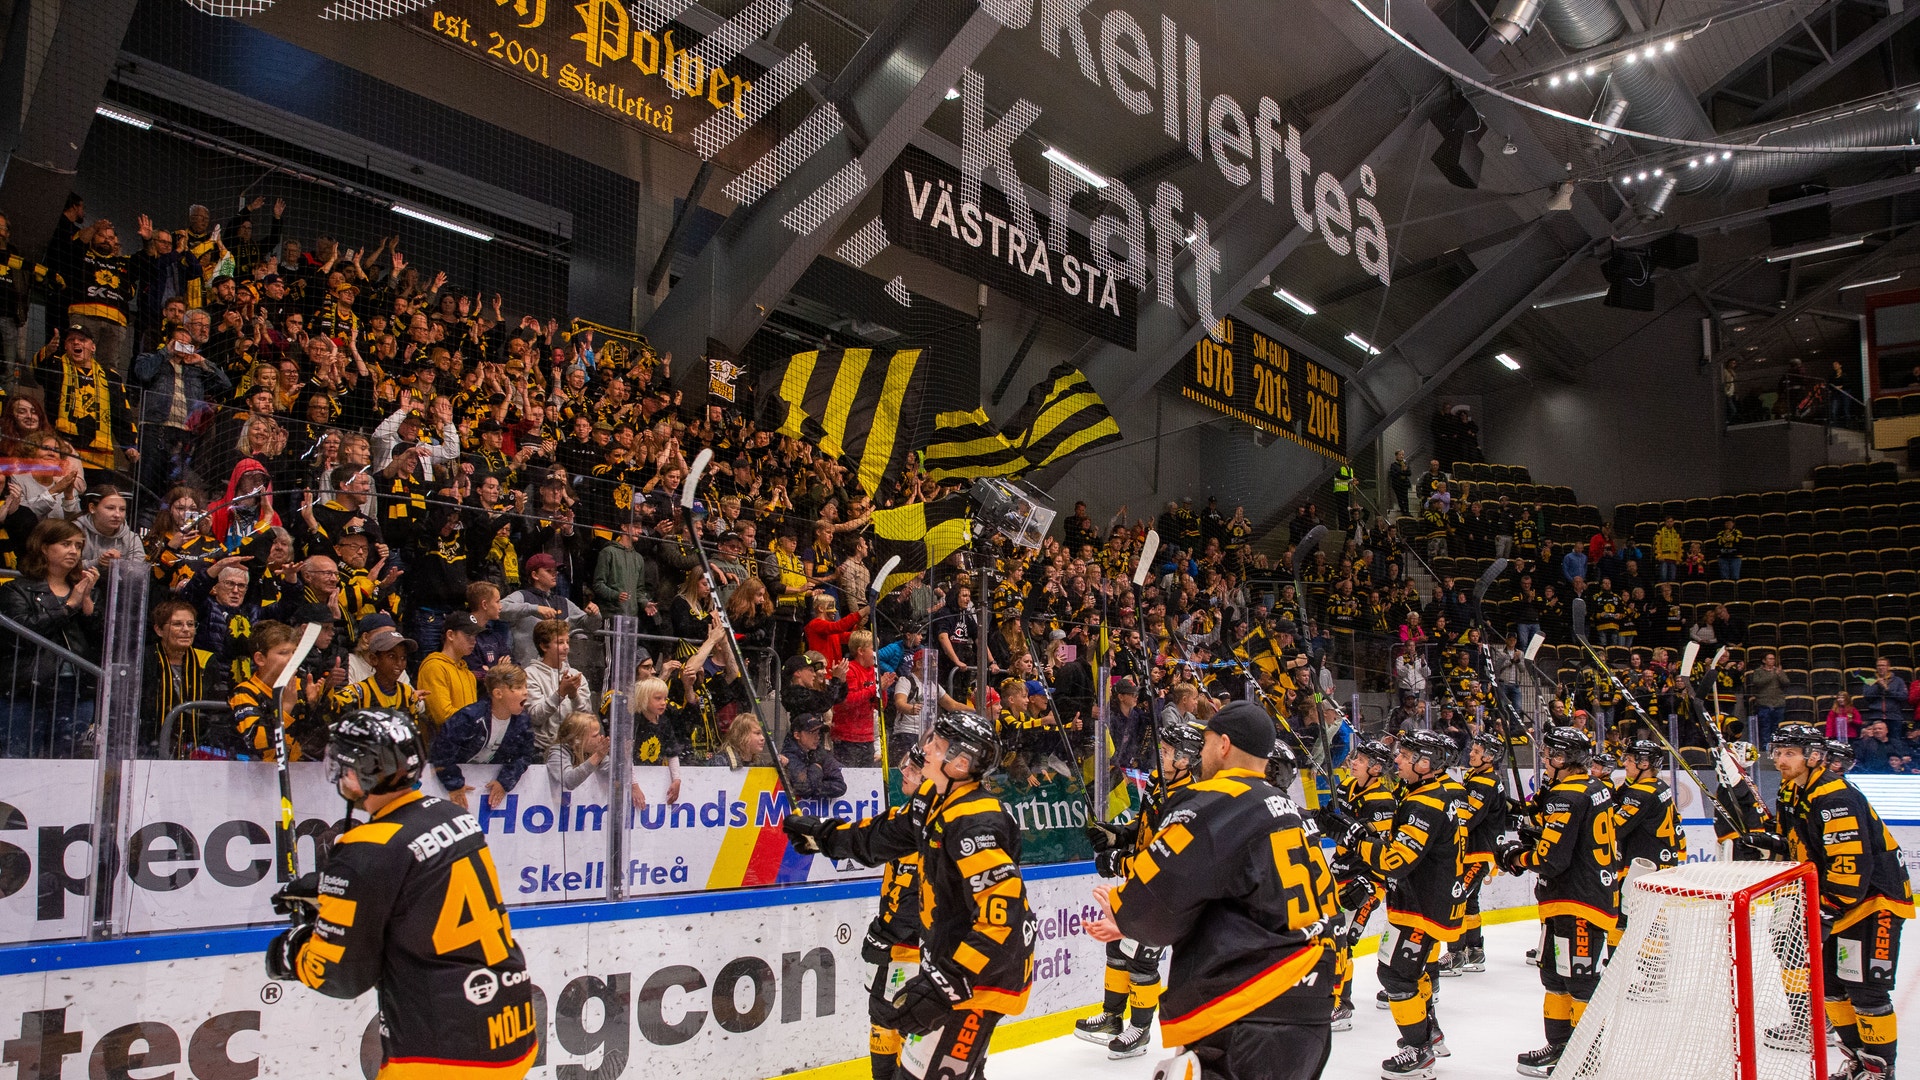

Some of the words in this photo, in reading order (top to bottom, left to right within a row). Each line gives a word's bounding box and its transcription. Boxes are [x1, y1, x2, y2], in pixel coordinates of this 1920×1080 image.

[433, 10, 478, 47] est.
[487, 31, 551, 80] 2001
[558, 62, 674, 134] Skellefteå
[571, 0, 752, 119] Power
[904, 170, 1053, 285] VÄSTRA
[1196, 338, 1235, 398] 1978
[1253, 332, 1289, 374] SM-GULD
[1253, 363, 1292, 413] 2013
[1306, 361, 1338, 398] SM-GULD
[1307, 390, 1340, 445] 2014
[1611, 676, 1646, 714] CCM
[274, 727, 286, 771] CCM
[519, 856, 688, 893] Skellfteå
[969, 870, 996, 892] SK
[1831, 856, 1857, 874] 25
[977, 897, 1008, 926] 16
[866, 933, 889, 949] CM
[1033, 947, 1071, 982] raft
[360, 946, 836, 1080] gcon
